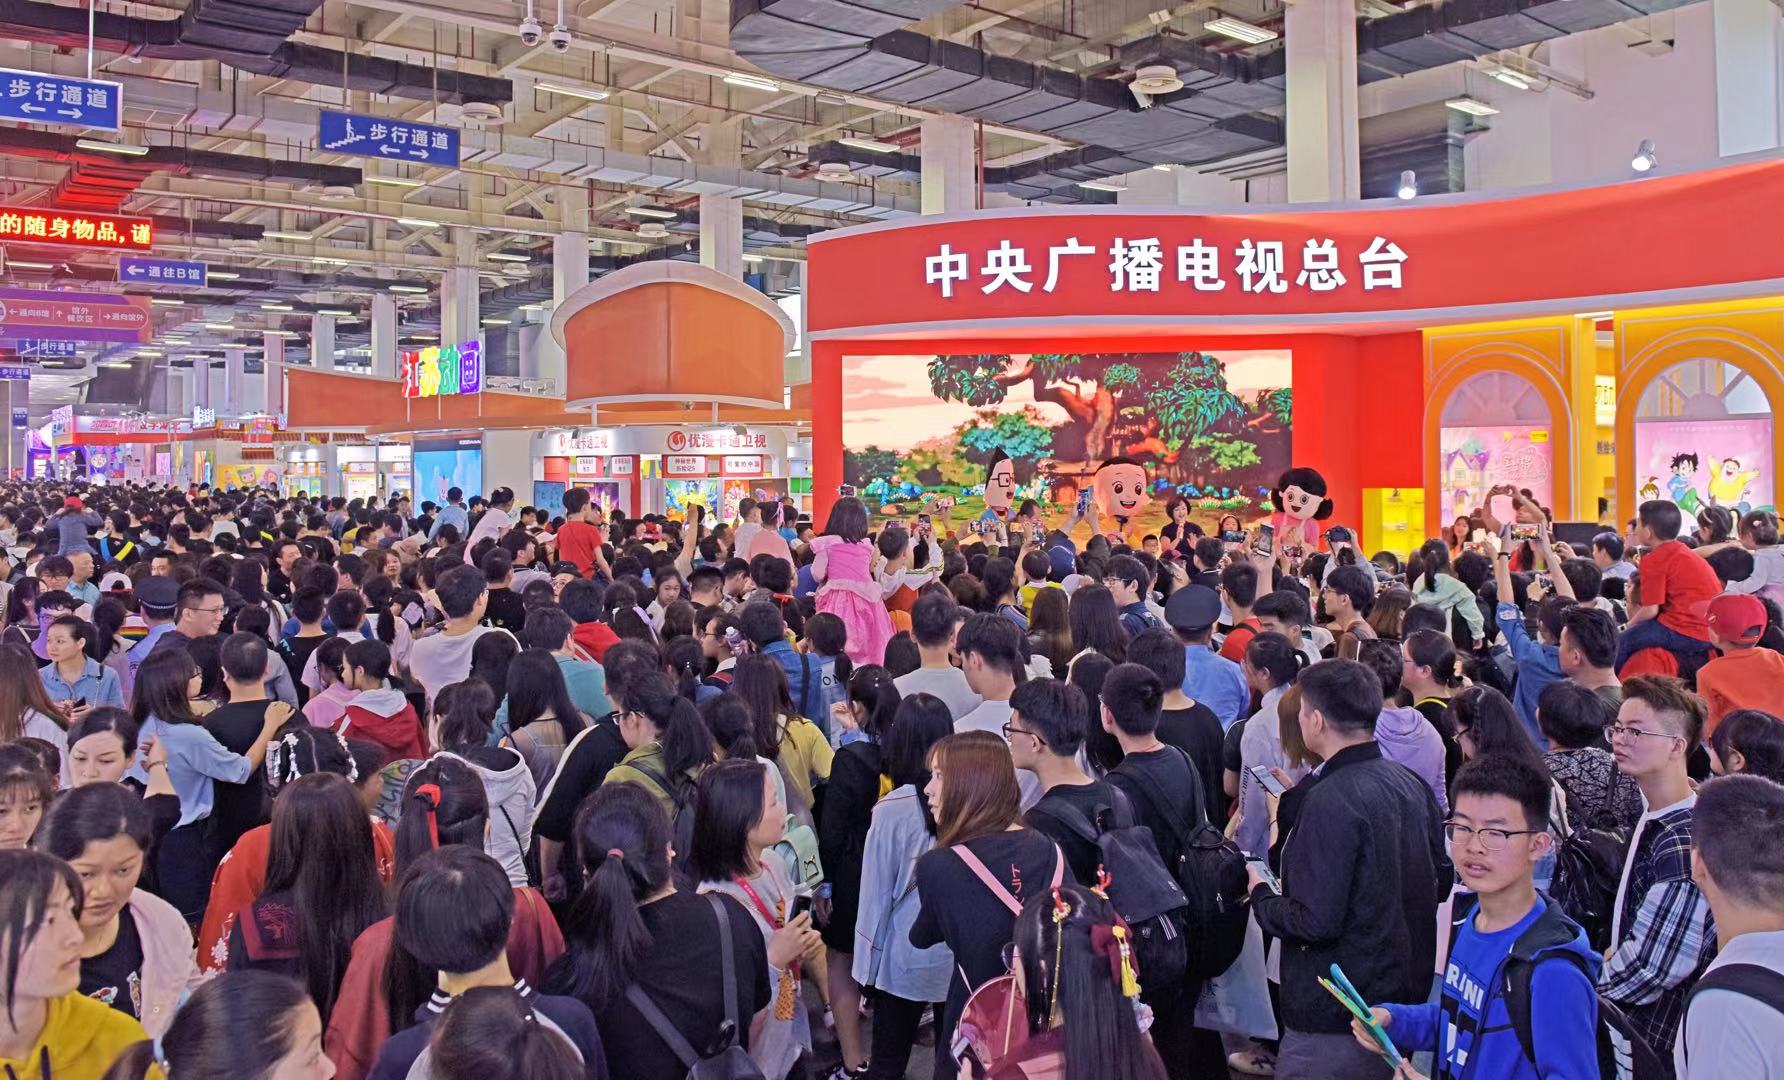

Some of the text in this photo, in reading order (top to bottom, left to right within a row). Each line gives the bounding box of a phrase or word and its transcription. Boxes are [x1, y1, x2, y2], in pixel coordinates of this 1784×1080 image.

[9, 79, 108, 108] 步行通道
[369, 123, 449, 150] 步行通道
[148, 266, 200, 280] 通往B馆
[925, 236, 1409, 298] 中央广播电视总台
[688, 433, 767, 449] 优漫卡通卫视
